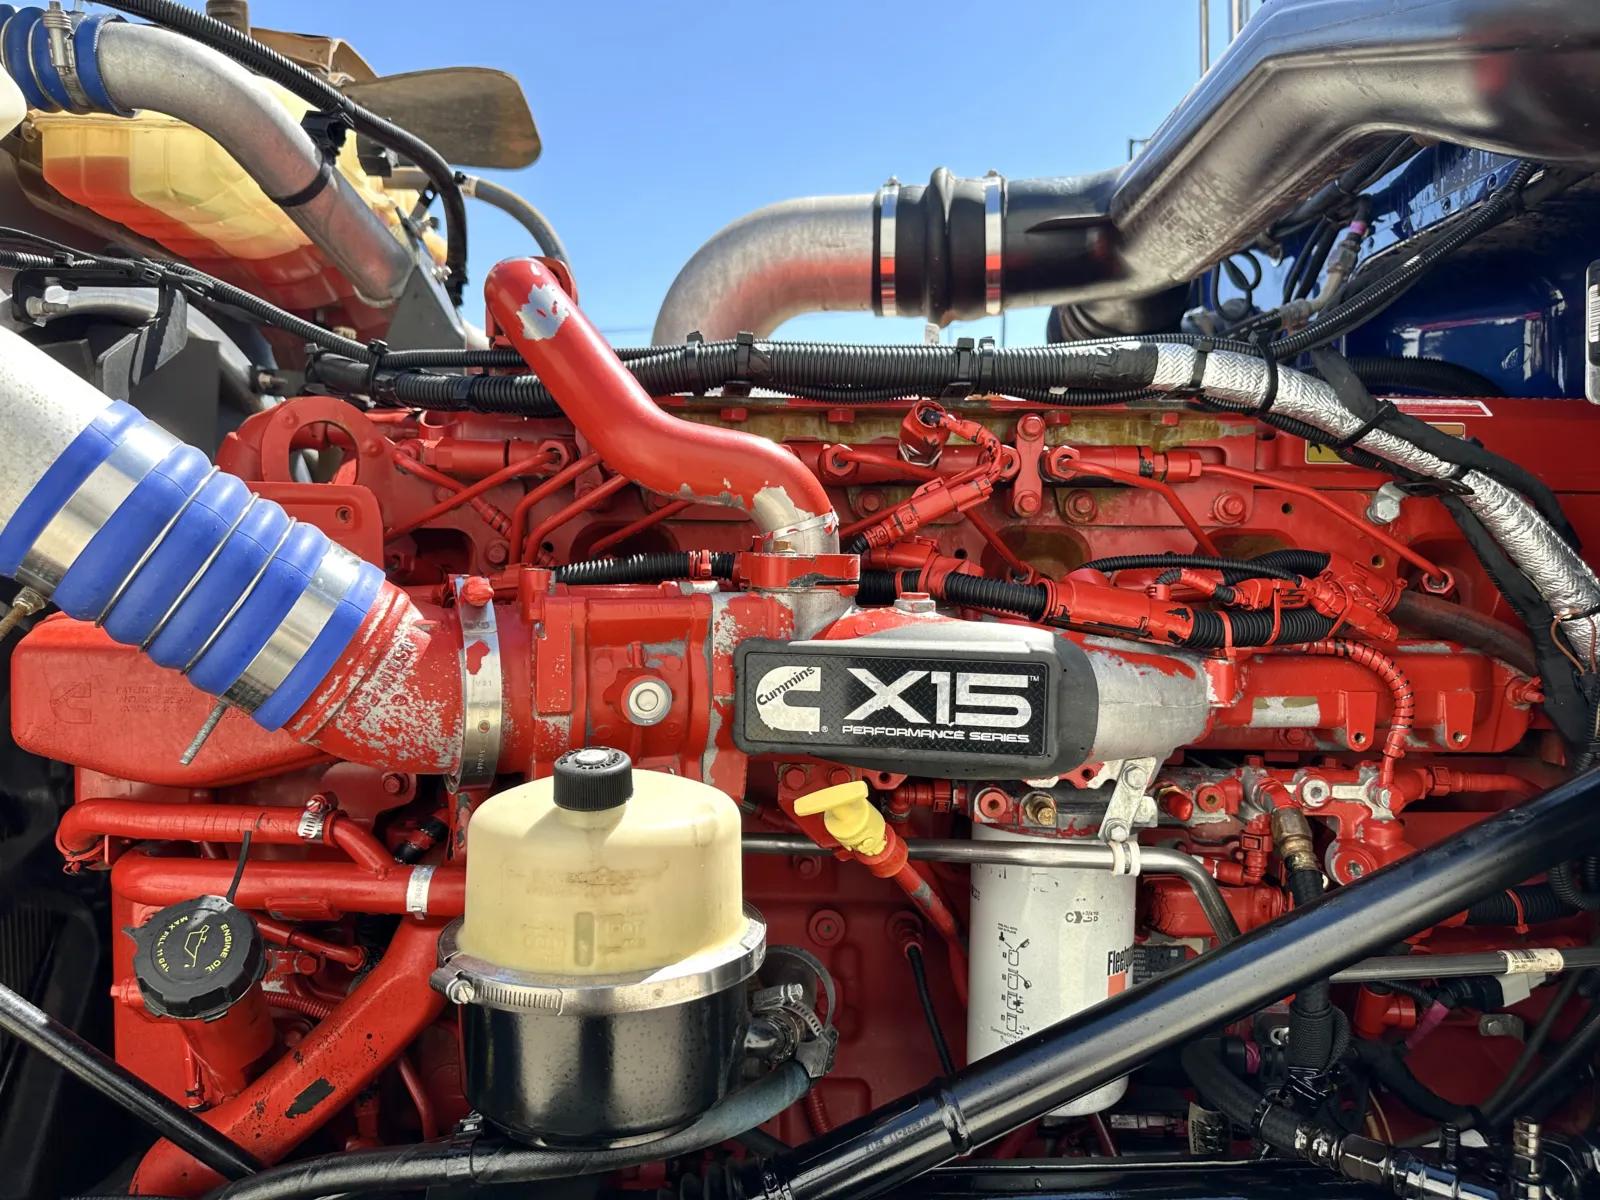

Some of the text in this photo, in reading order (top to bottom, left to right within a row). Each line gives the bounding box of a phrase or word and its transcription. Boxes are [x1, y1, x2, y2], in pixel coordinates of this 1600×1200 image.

[757, 666, 815, 706] Cummins
[843, 667, 1032, 728] X15
[842, 725, 1030, 743] PERFORMANCE SERIES
[168, 916, 188, 930] MAX
[157, 931, 169, 946] FILL
[205, 923, 232, 971] ENGINE OIL
[158, 958, 170, 972] GAL
